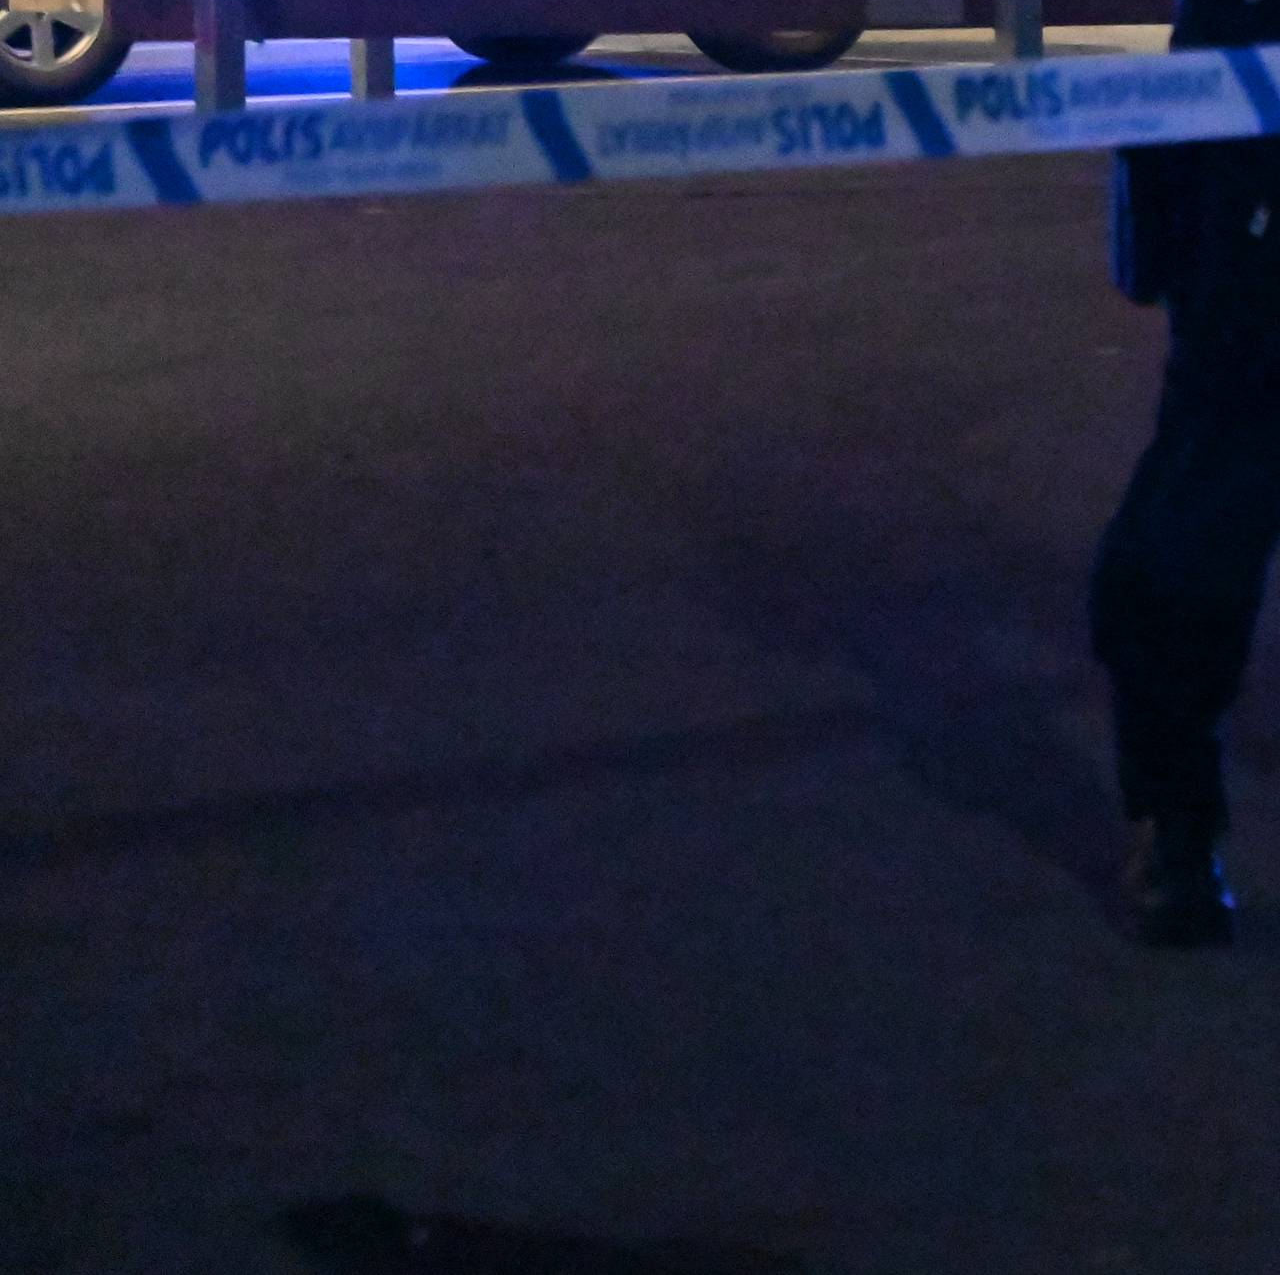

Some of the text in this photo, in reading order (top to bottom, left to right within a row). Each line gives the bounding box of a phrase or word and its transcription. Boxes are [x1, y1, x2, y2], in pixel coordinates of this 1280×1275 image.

[954, 69, 1065, 123] POLIS
[201, 111, 323, 167] POLIS
[771, 104, 886, 157] POLIS
